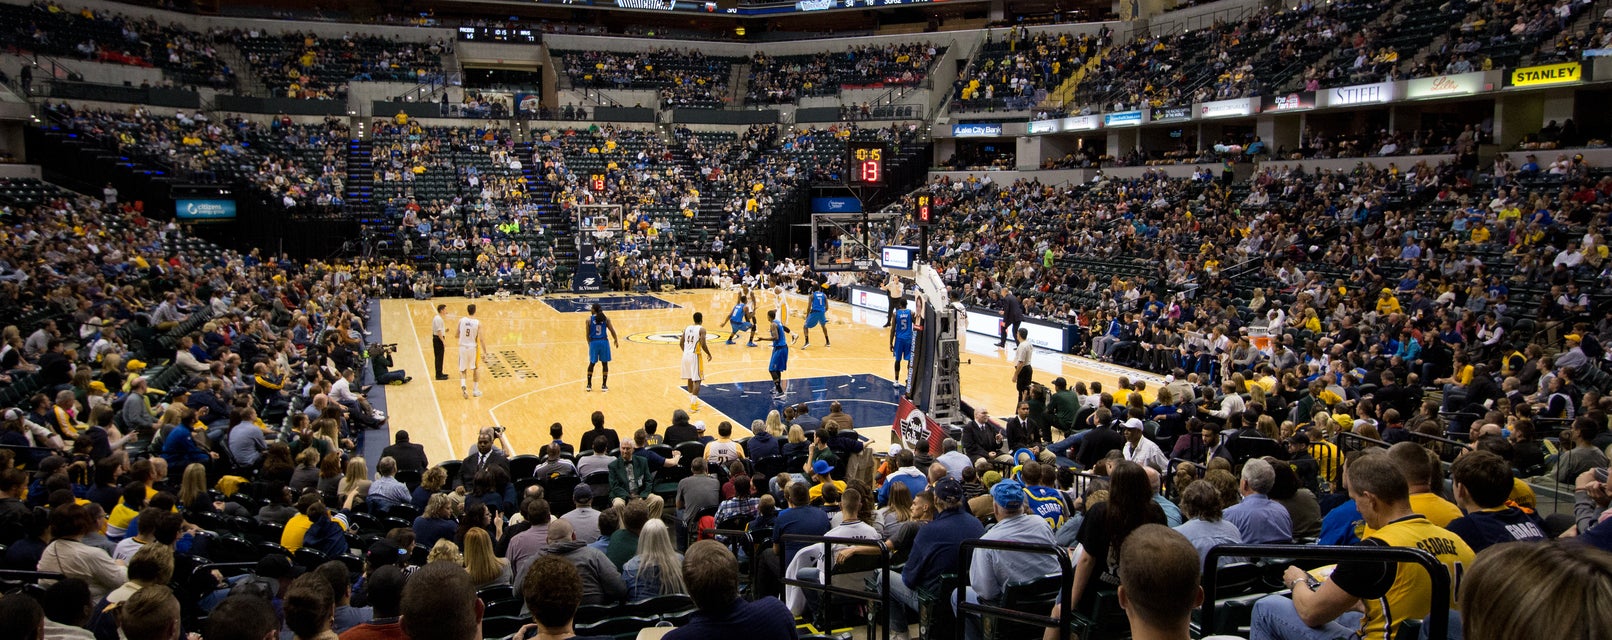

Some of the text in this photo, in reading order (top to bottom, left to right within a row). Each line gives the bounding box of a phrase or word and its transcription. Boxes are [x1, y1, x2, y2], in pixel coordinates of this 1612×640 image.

[1517, 67, 1576, 82] STANLEY
[1431, 76, 1458, 92] Lilly
[1337, 86, 1382, 103] STIFEL
[973, 127, 985, 135] City
[863, 161, 877, 181] 13
[594, 180, 604, 190] 13
[595, 325, 602, 336] 9
[901, 319, 907, 330] 5
[909, 417, 923, 433] Steak
[1037, 503, 1061, 516] GEORGE
[1416, 537, 1459, 557] GEORGE
